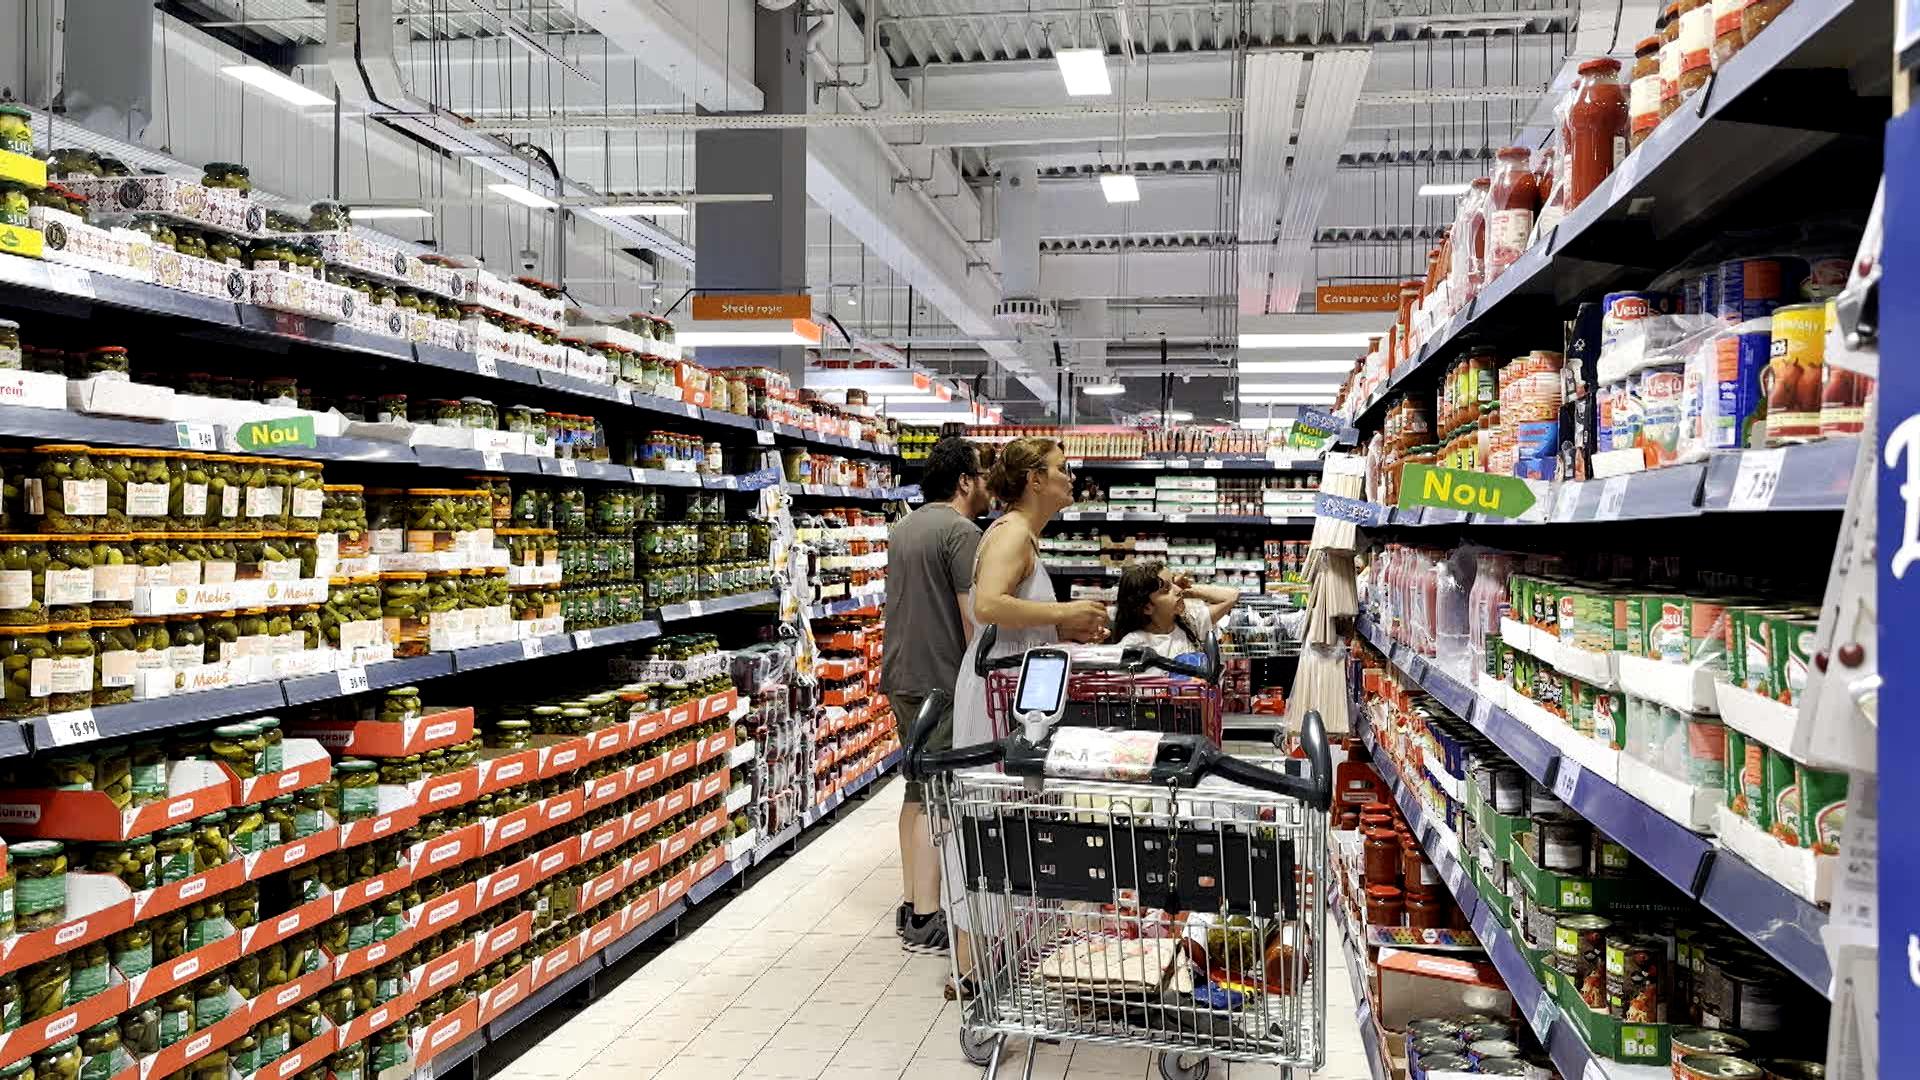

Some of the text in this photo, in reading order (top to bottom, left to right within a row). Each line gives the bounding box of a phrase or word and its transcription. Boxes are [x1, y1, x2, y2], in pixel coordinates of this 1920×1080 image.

[1323, 294, 1378, 303] Conserve
[251, 424, 298, 445] Nou
[1299, 424, 1322, 436] Nou
[1294, 435, 1317, 448] Nou
[1423, 470, 1501, 509] Nou
[69, 721, 96, 738] 15.99
[1603, 854, 1628, 867] Bio
[1563, 892, 1591, 906] Bio
[1556, 937, 1577, 954] Bio
[1606, 960, 1624, 975] Bio
[1625, 1039, 1656, 1056] Bio
